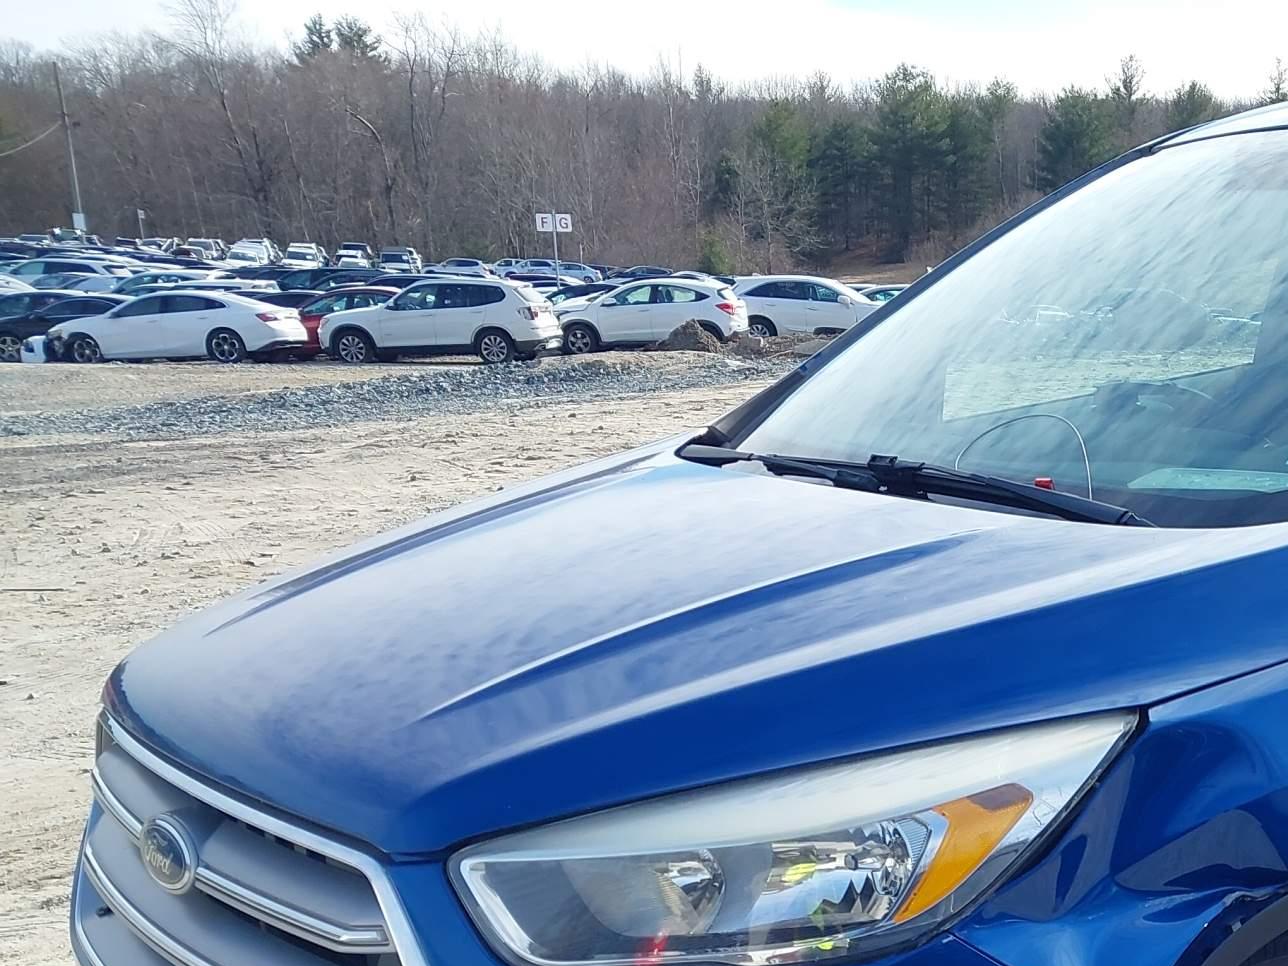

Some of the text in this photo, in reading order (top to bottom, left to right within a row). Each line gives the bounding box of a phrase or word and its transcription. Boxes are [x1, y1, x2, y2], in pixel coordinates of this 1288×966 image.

[540, 216, 548, 229] F
[559, 216, 569, 229] G
[144, 831, 174, 875] Ford
